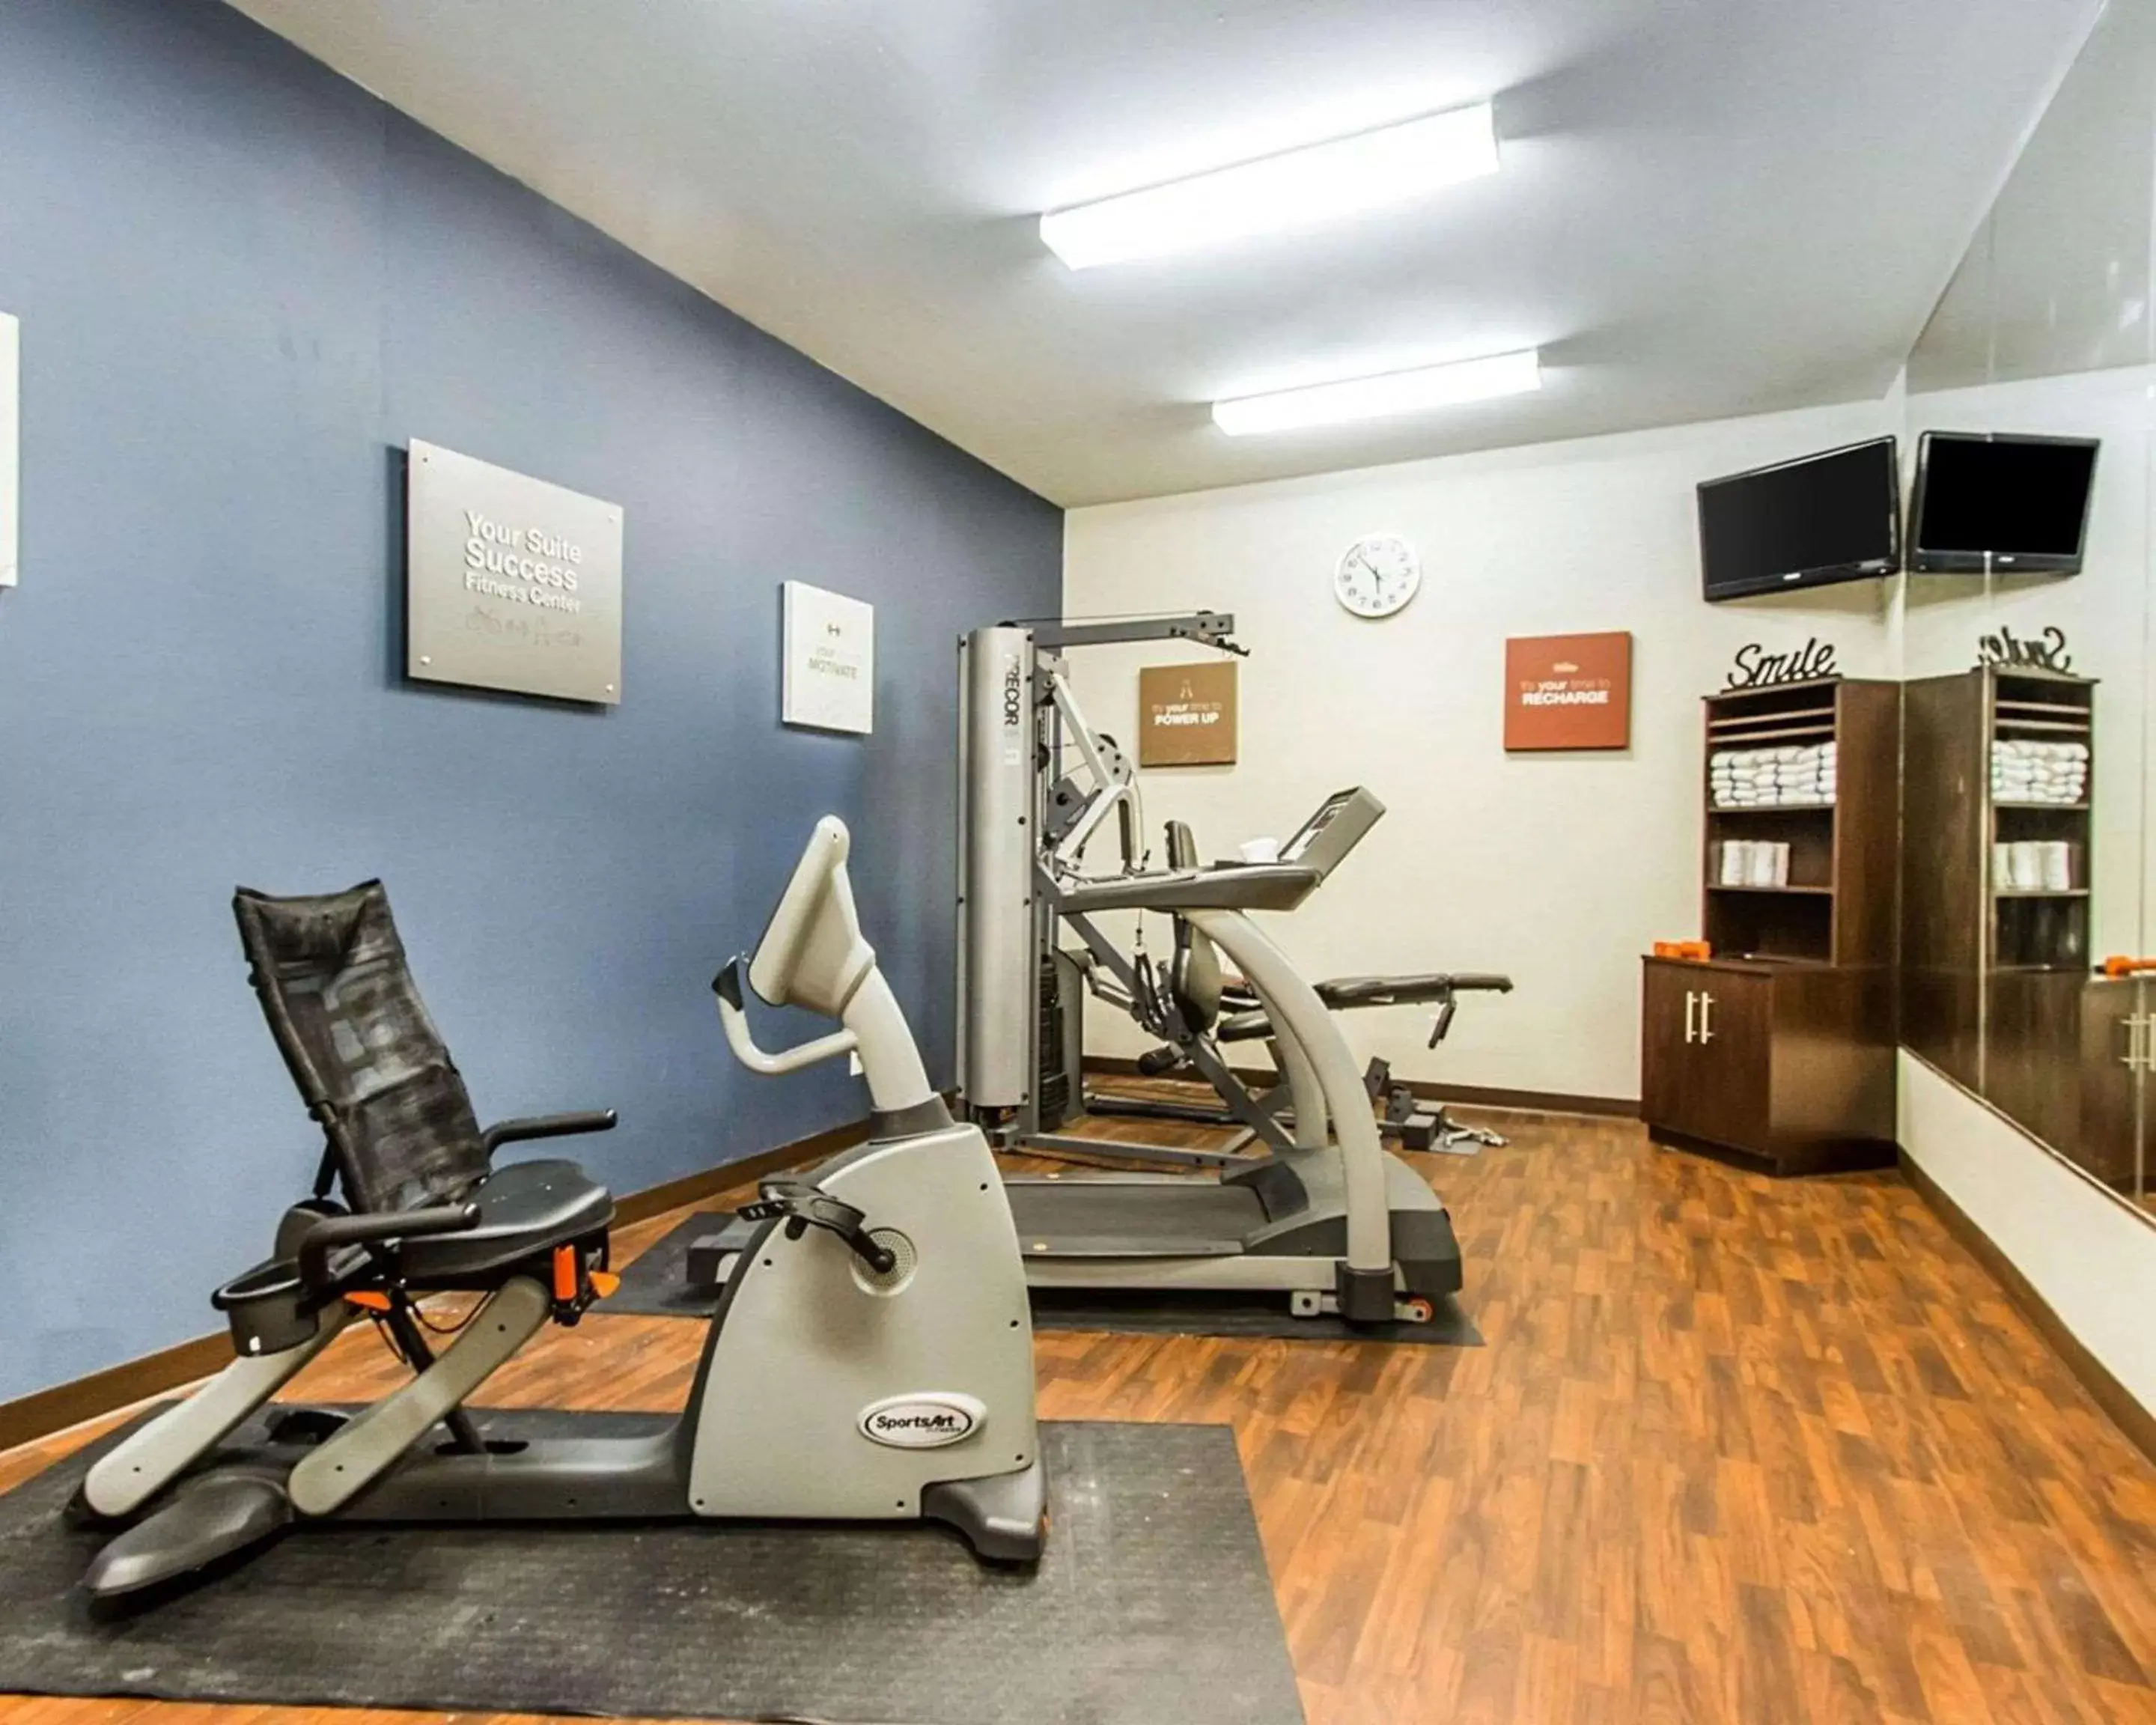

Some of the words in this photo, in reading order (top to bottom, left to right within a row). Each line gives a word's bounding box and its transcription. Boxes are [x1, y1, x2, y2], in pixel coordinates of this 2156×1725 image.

[464, 510, 522, 548] Your
[526, 529, 582, 565] Suite
[464, 538, 578, 591] Success
[465, 572, 527, 603] Fitness
[529, 587, 581, 615] Center
[1727, 637, 1836, 689] Smile
[1522, 690, 1609, 706] RECHARGE
[1538, 681, 1568, 693] your
[1154, 713, 1199, 725] POWER
[1201, 711, 1219, 725] UP
[876, 1414, 954, 1431] SportsArt
